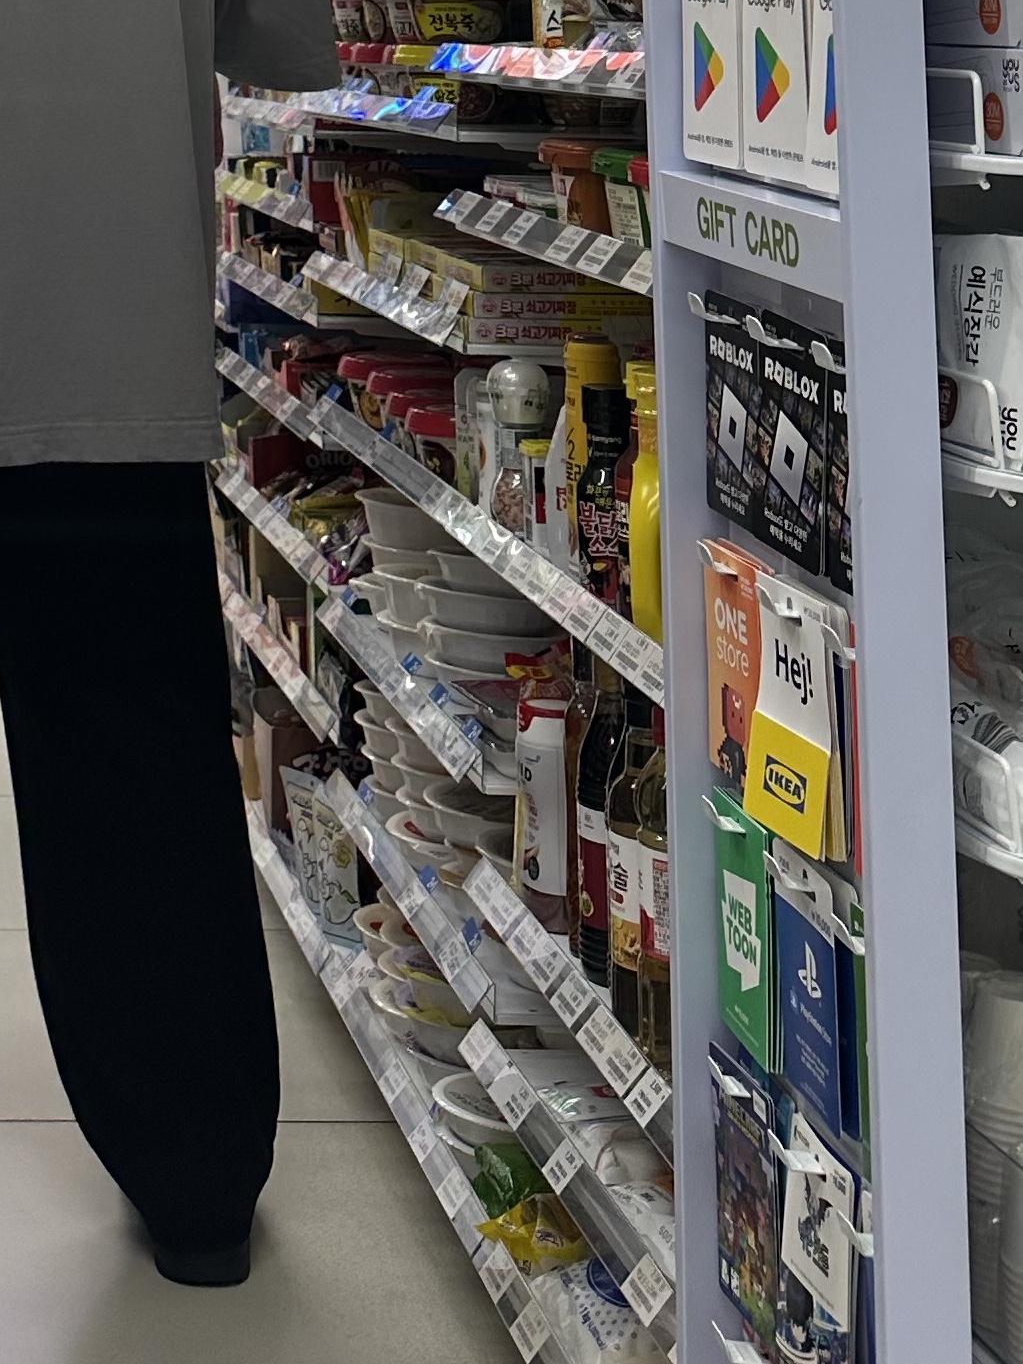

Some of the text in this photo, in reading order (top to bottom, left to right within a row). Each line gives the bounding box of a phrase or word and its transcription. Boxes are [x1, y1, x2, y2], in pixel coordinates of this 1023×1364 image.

[428, 13, 475, 32] 전복죽
[696, 196, 800, 269] GIFT CARD
[985, 266, 1005, 331] 부드러운
[708, 334, 755, 375] ROBLOX
[764, 356, 820, 406] ROBLOX
[579, 499, 621, 536] 불닭
[714, 597, 748, 646] ONE
[716, 635, 750, 678] store
[774, 637, 814, 706] Hej!
[767, 766, 804, 802] IKEA
[727, 892, 753, 936] WEB
[726, 914, 757, 968] TOON
